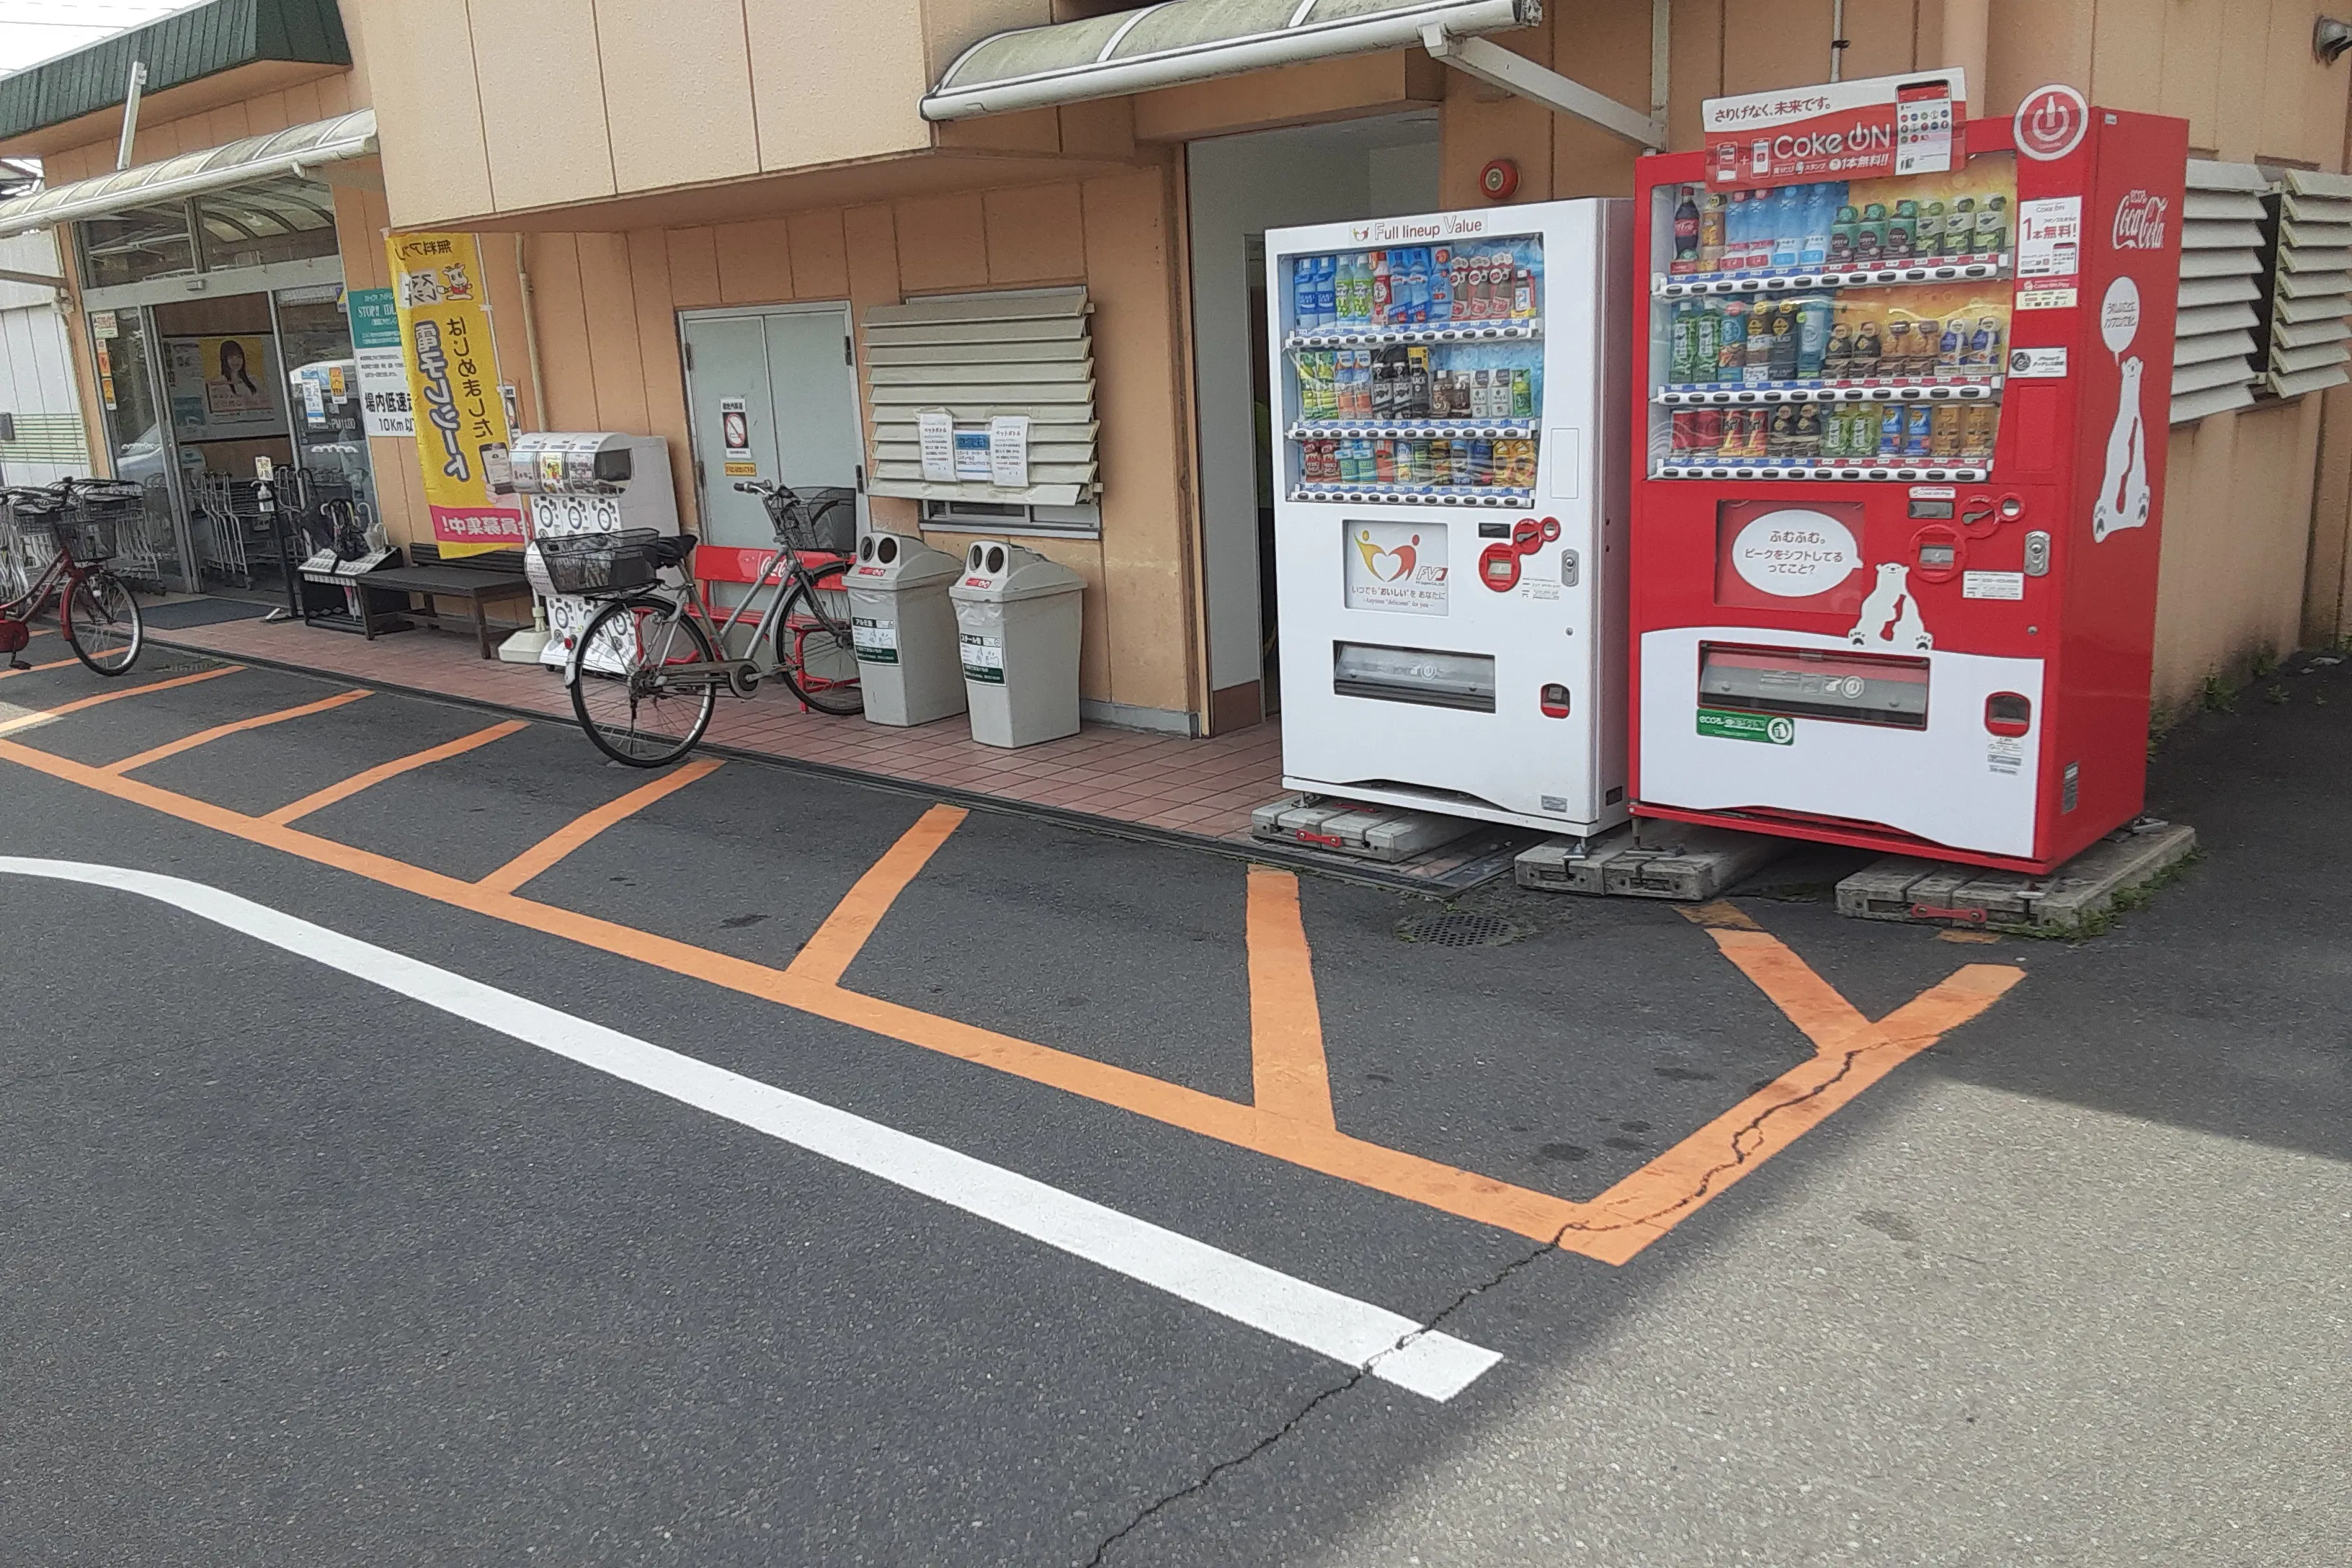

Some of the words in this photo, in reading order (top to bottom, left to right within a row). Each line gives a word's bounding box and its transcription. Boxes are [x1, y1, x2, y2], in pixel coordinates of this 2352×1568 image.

[1714, 95, 1830, 122] さりげなく、未来です。
[1774, 133, 1843, 159] Coke
[1848, 121, 1890, 151] ON
[1375, 222, 1399, 241] Full
[1402, 225, 1440, 239] lineup
[1443, 215, 1482, 233] Value
[1770, 530, 1825, 544] ふむふむ。
[1745, 548, 1843, 562] ピークをシフトしてる
